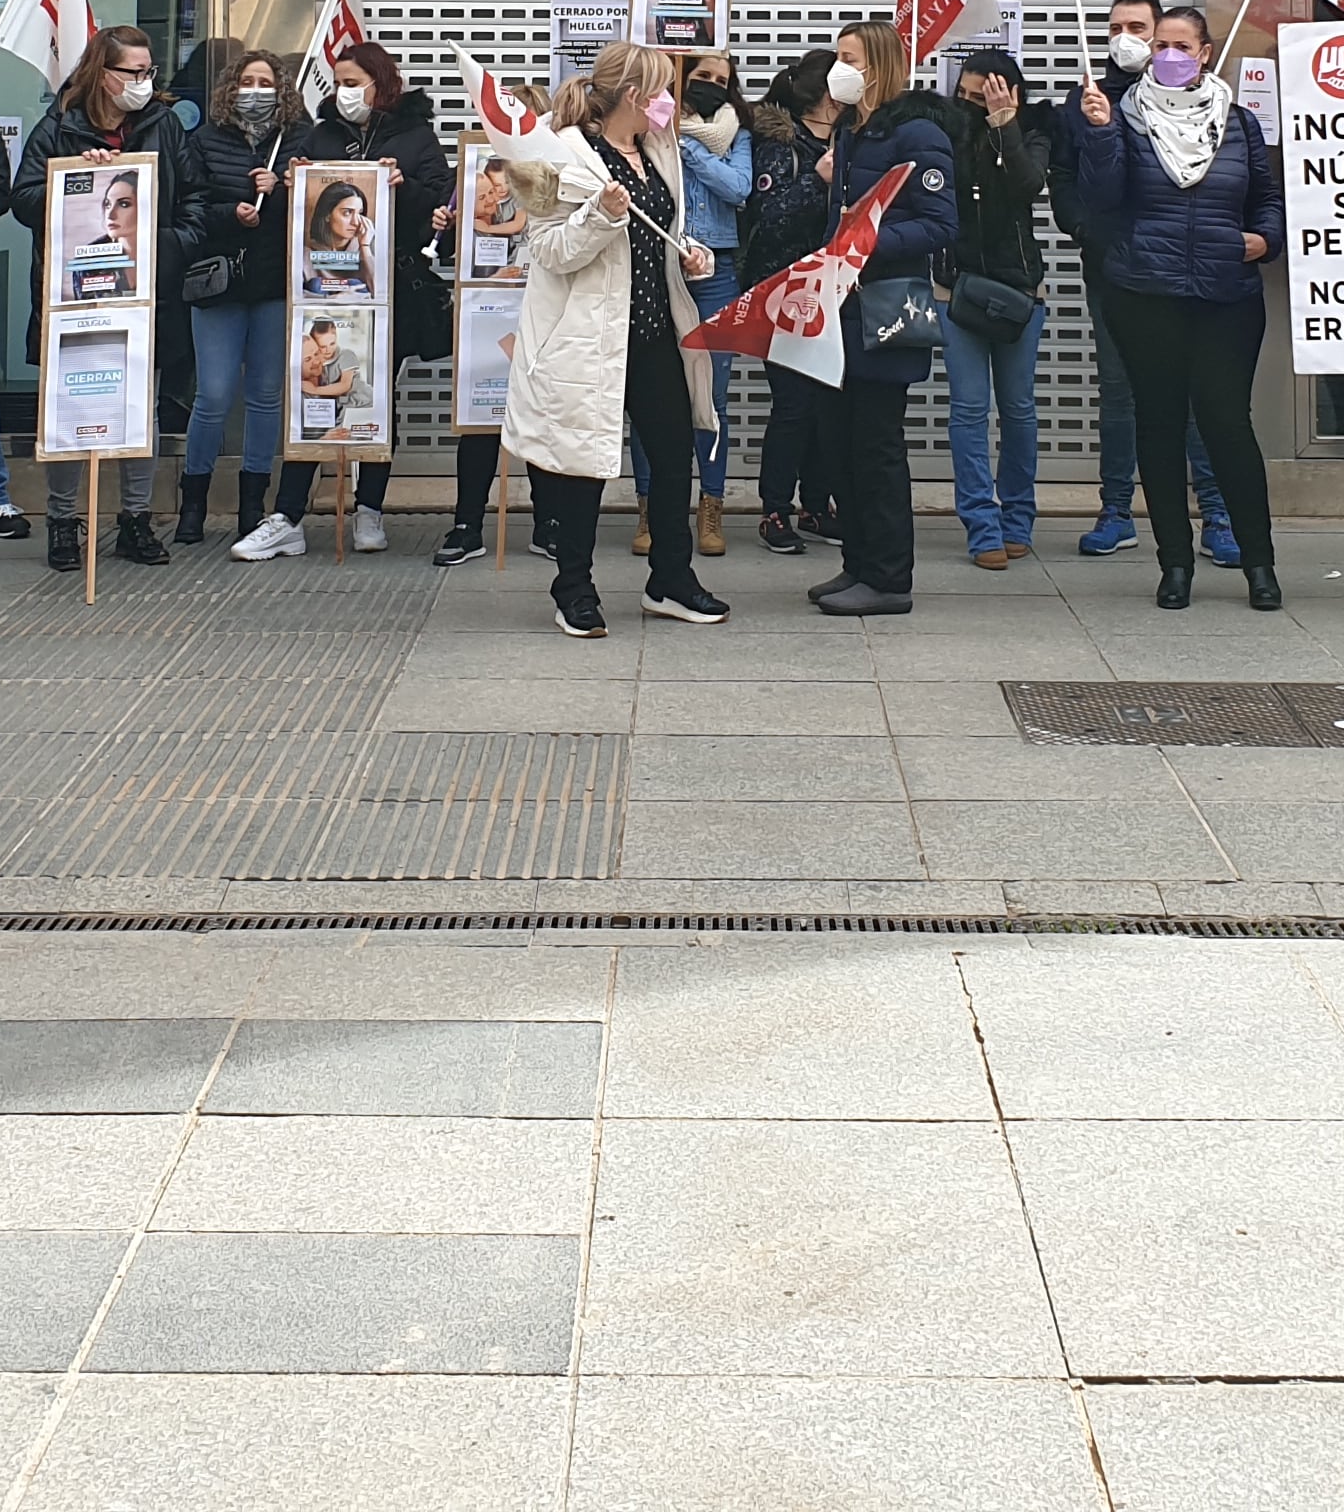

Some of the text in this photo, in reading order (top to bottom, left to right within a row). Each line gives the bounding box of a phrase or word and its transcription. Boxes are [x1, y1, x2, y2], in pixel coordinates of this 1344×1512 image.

[554, 8, 628, 16] CERRADO POR
[1245, 70, 1265, 81] NO
[66, 182, 91, 193] SOS
[310, 251, 359, 262] DESPIDEN
[878, 317, 905, 342] Sweet
[65, 371, 123, 384] CIERRAN
